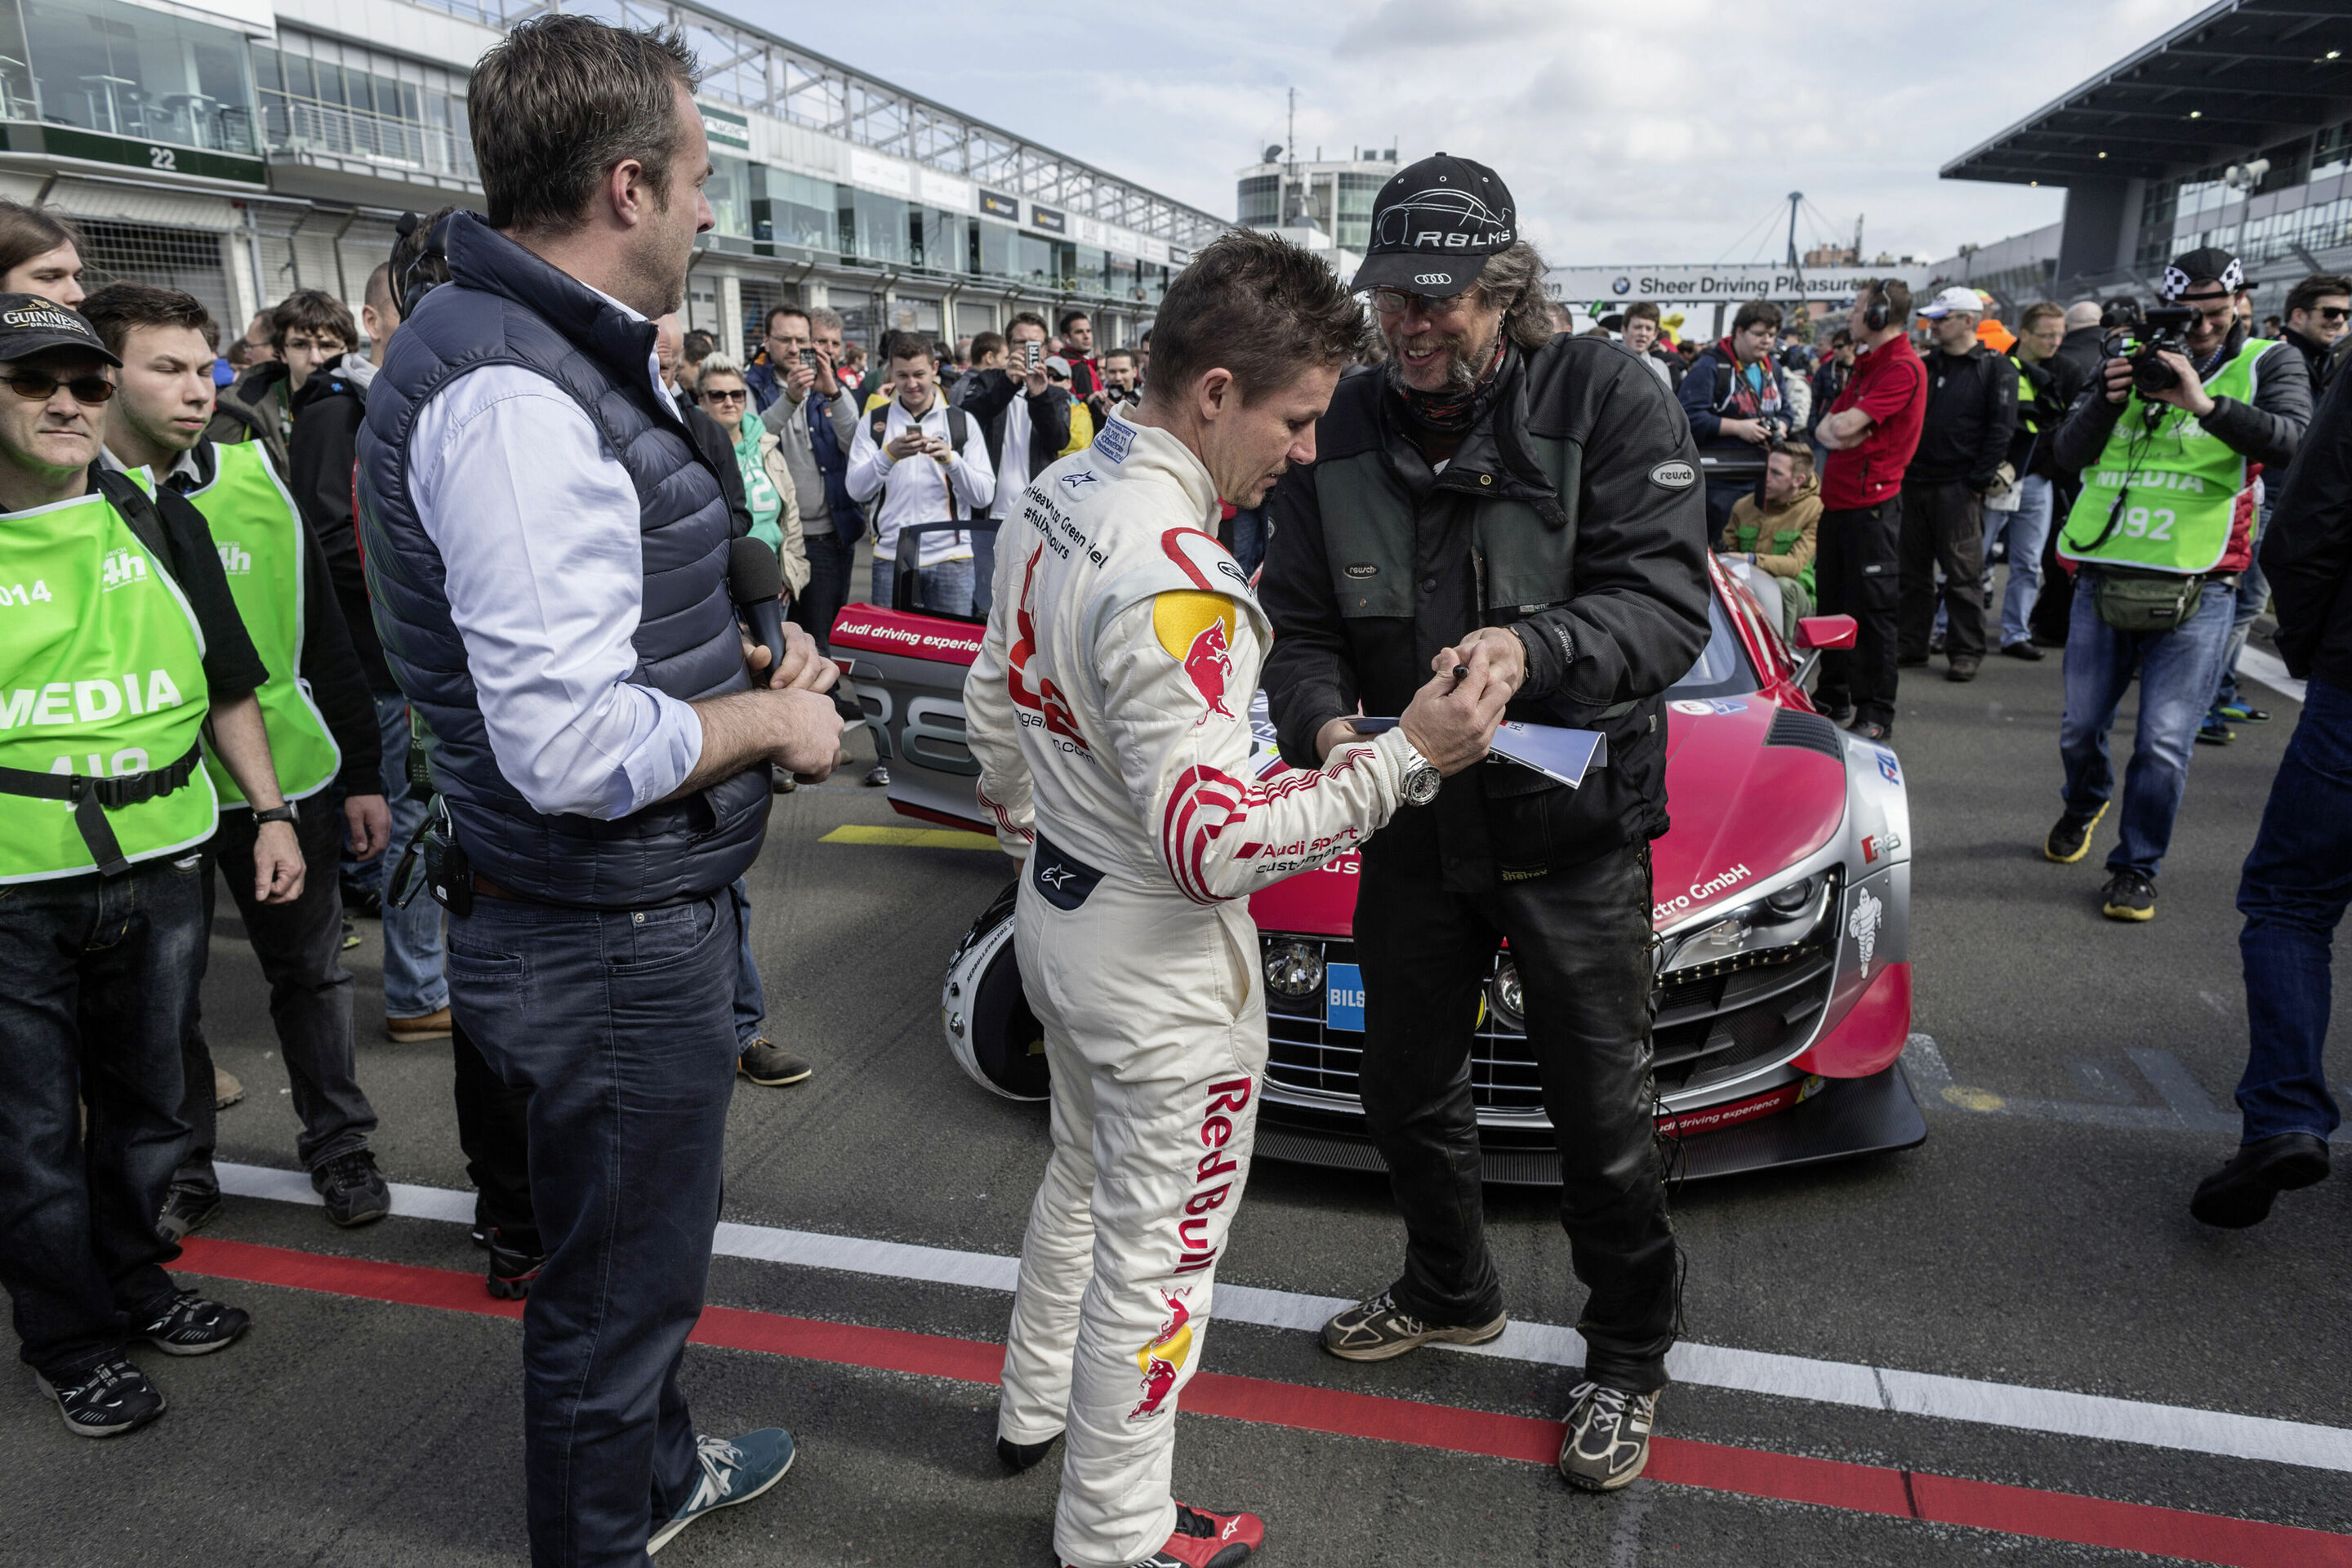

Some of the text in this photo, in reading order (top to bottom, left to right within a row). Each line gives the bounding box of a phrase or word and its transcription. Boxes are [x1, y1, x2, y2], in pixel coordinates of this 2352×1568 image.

[149, 146, 177, 171] 22
[1640, 277, 1696, 294] Sheer
[1701, 276, 1769, 300] Driving
[2, 310, 90, 336] GUINNESS
[1659, 469, 1692, 480] reusch
[2096, 470, 2204, 494] MEDIA
[1061, 516, 1087, 547] Green
[1349, 565, 1375, 574] reusch
[836, 621, 872, 637] Audi
[871, 625, 921, 646] driving
[1261, 841, 1306, 858] Audi
[1309, 826, 1359, 851] Sport
[1256, 845, 1342, 874] customer
[1690, 863, 1752, 899] GmbH
[1680, 1114, 1720, 1129] driving
[1722, 1098, 1780, 1120] experience
